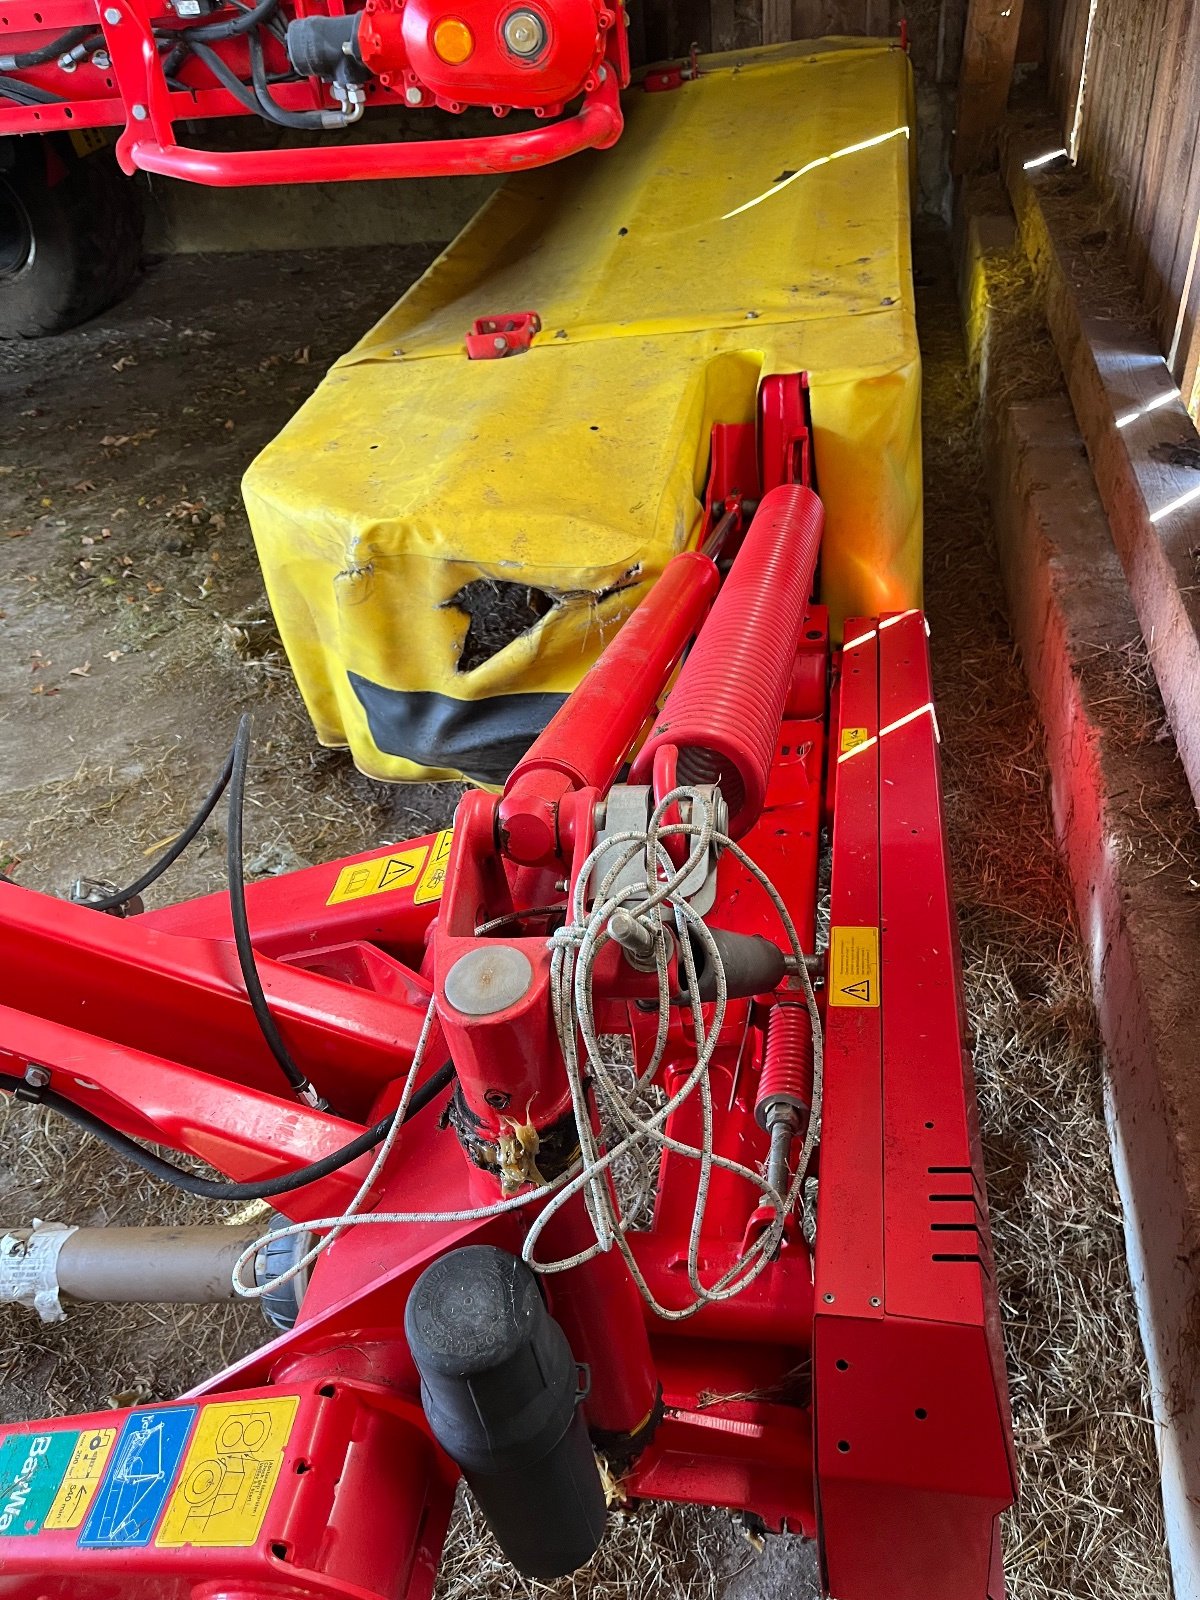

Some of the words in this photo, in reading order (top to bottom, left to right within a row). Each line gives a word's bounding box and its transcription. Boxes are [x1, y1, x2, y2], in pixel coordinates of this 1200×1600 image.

[73, 1450, 82, 1465] 200
[0, 1436, 52, 1530] BayWa
[65, 1484, 77, 1502] 540
